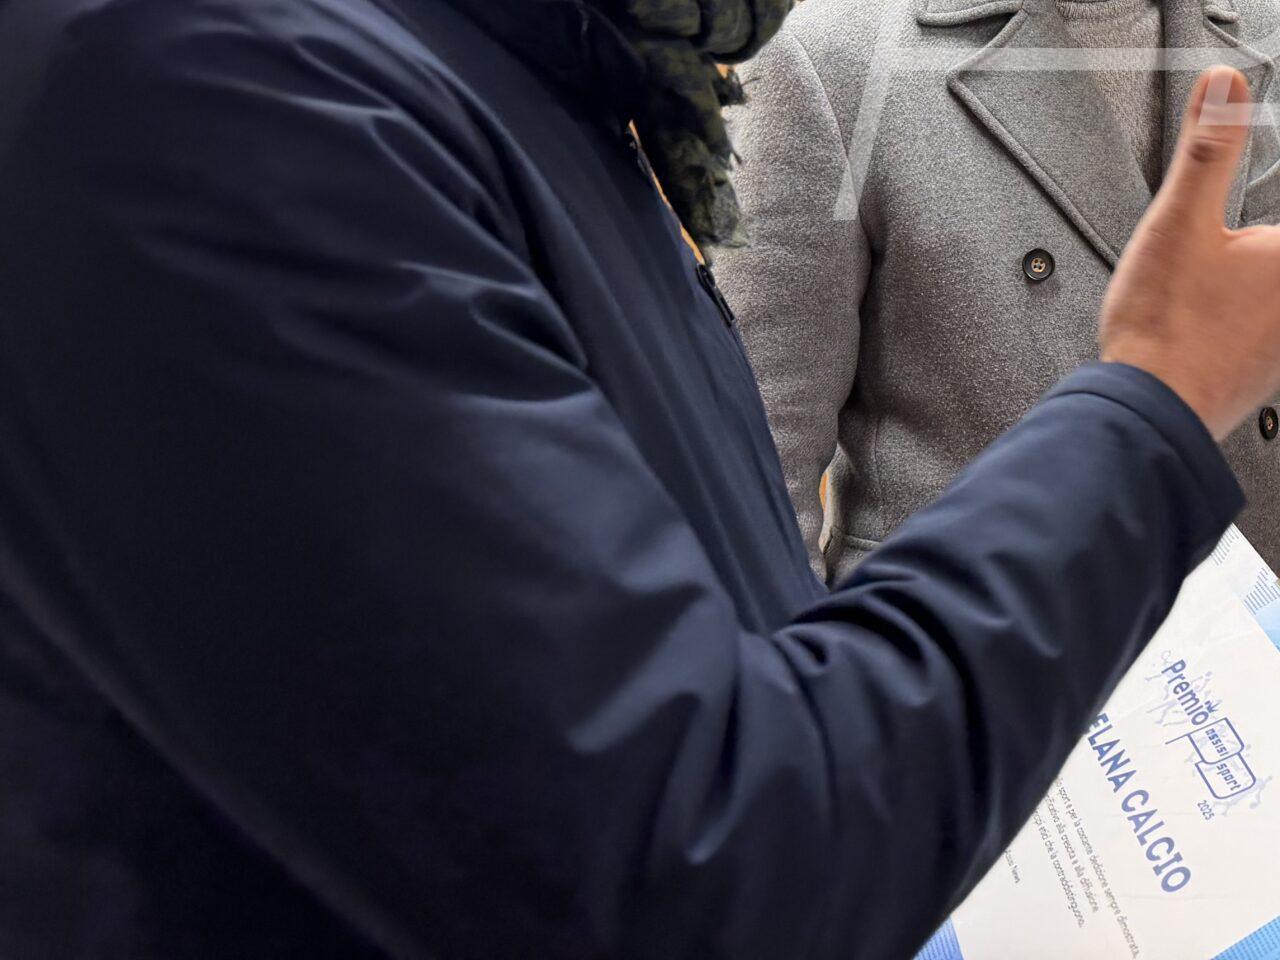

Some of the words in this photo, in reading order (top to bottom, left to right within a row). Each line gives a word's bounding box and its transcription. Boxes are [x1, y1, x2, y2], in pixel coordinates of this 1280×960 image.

[1161, 658, 1209, 726] Premio
[1204, 727, 1230, 757] assisi
[1196, 799, 1215, 821] 2025
[1215, 762, 1242, 792] sport
[1060, 833, 1077, 860] crescita
[1079, 877, 1099, 913] diffusione
[1076, 826, 1094, 856] costante
[1089, 854, 1109, 889] dedizione
[1103, 887, 1122, 916] sempre
[1121, 789, 1192, 893] CALCIO
